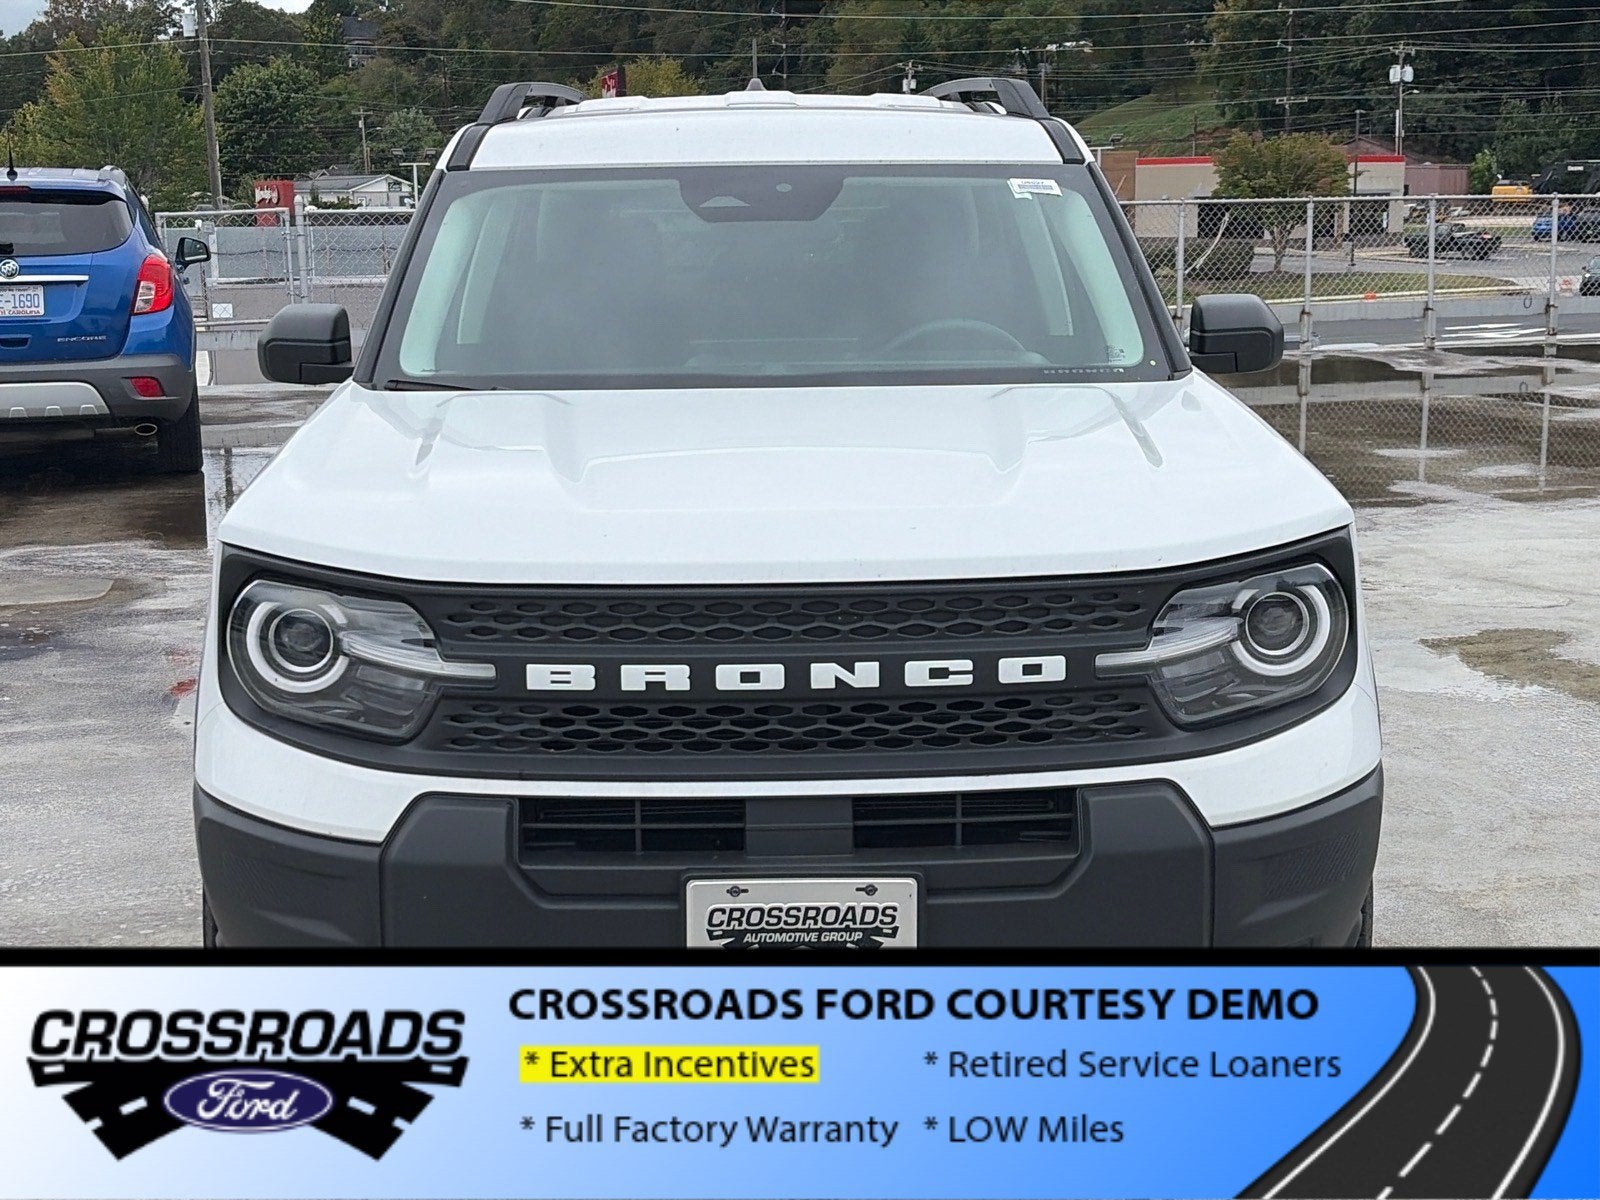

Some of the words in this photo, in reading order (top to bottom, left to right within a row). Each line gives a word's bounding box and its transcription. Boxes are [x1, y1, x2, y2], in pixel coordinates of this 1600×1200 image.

[526, 655, 1067, 691] BRONCO
[707, 905, 898, 928] CROSSROADS
[743, 933, 818, 944] AUTOMOTIVE
[820, 932, 863, 942] GROUP
